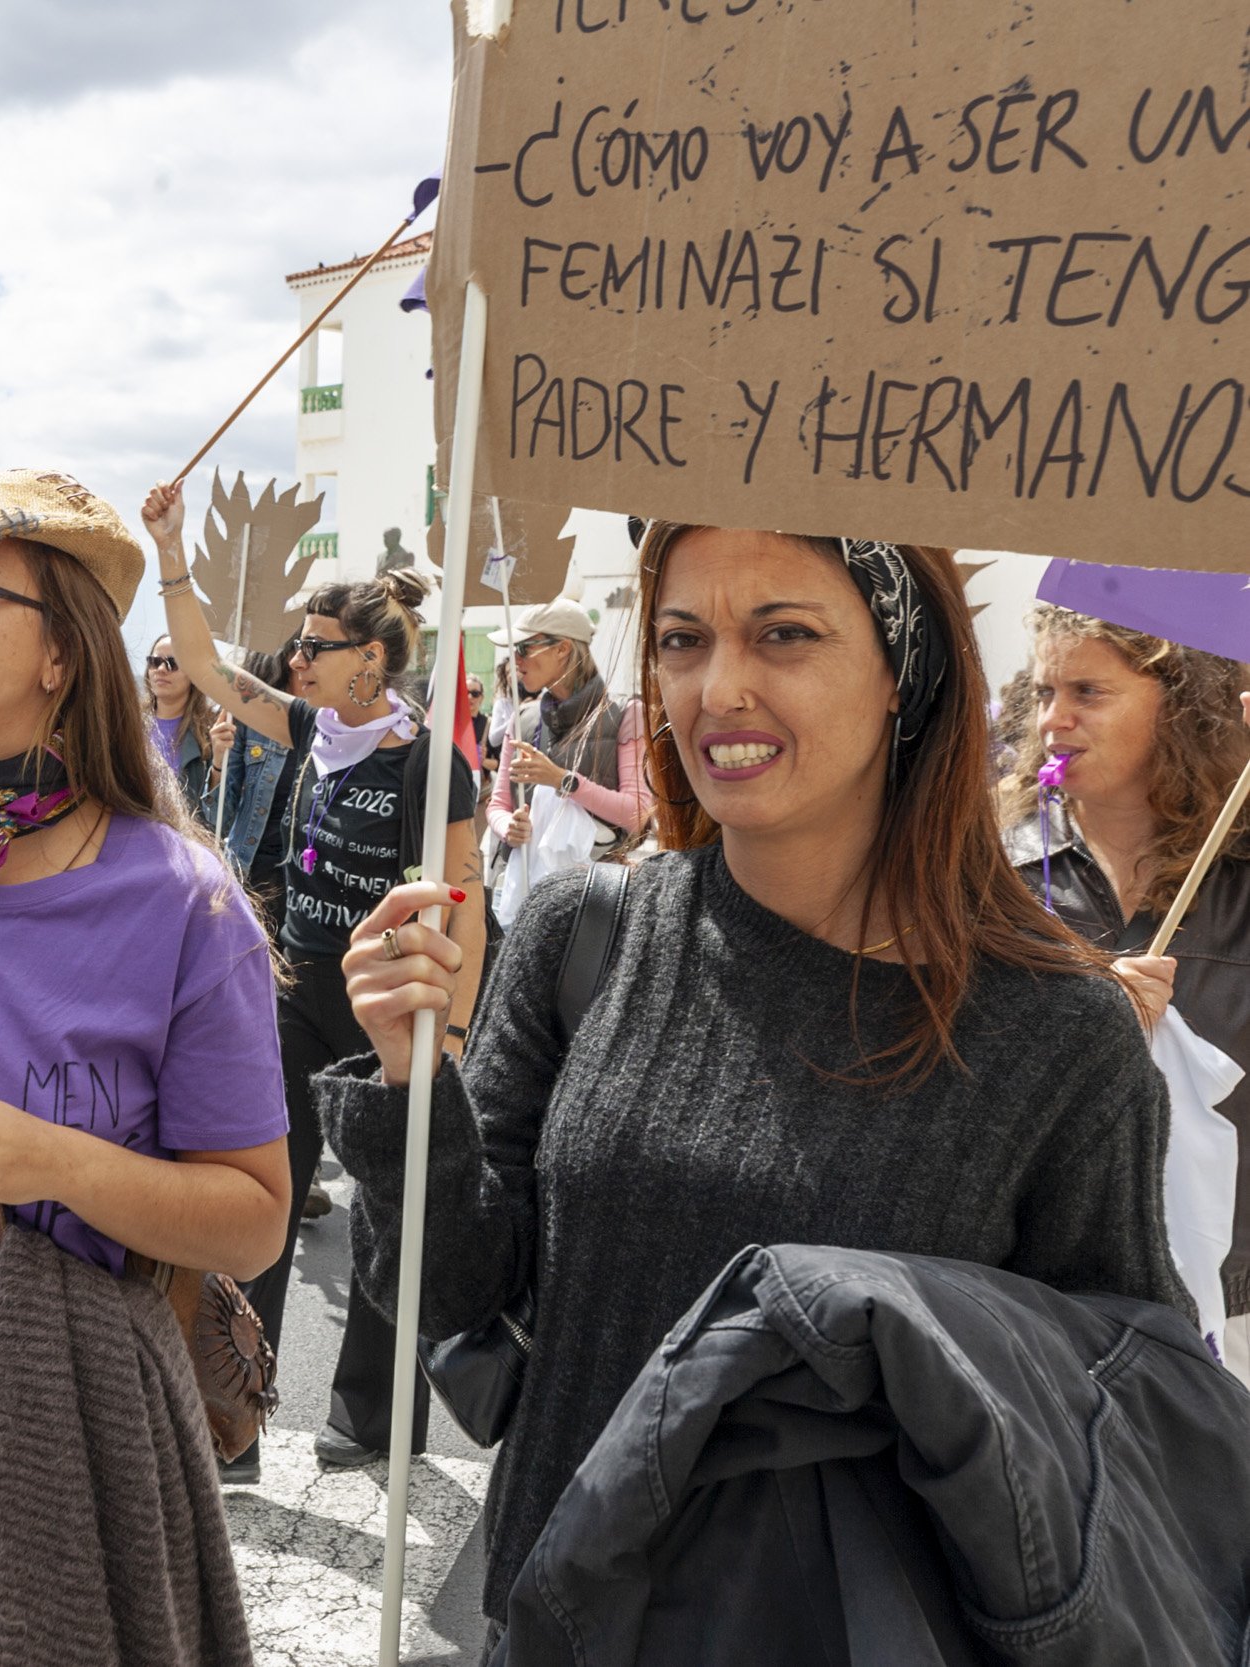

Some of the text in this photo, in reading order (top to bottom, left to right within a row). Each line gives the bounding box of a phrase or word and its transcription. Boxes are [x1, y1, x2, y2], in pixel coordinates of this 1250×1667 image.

[748, 108, 851, 192] VOY
[871, 106, 923, 183] A
[949, 90, 1088, 174] SER
[1128, 85, 1250, 164] UN
[521, 225, 1250, 327] FEMINAZI SI TENG
[510, 353, 687, 467] PADRE
[737, 380, 779, 484] Y
[341, 787, 398, 817] 2026
[348, 842, 399, 859] SUMISAS
[23, 1058, 121, 1130] MEN
